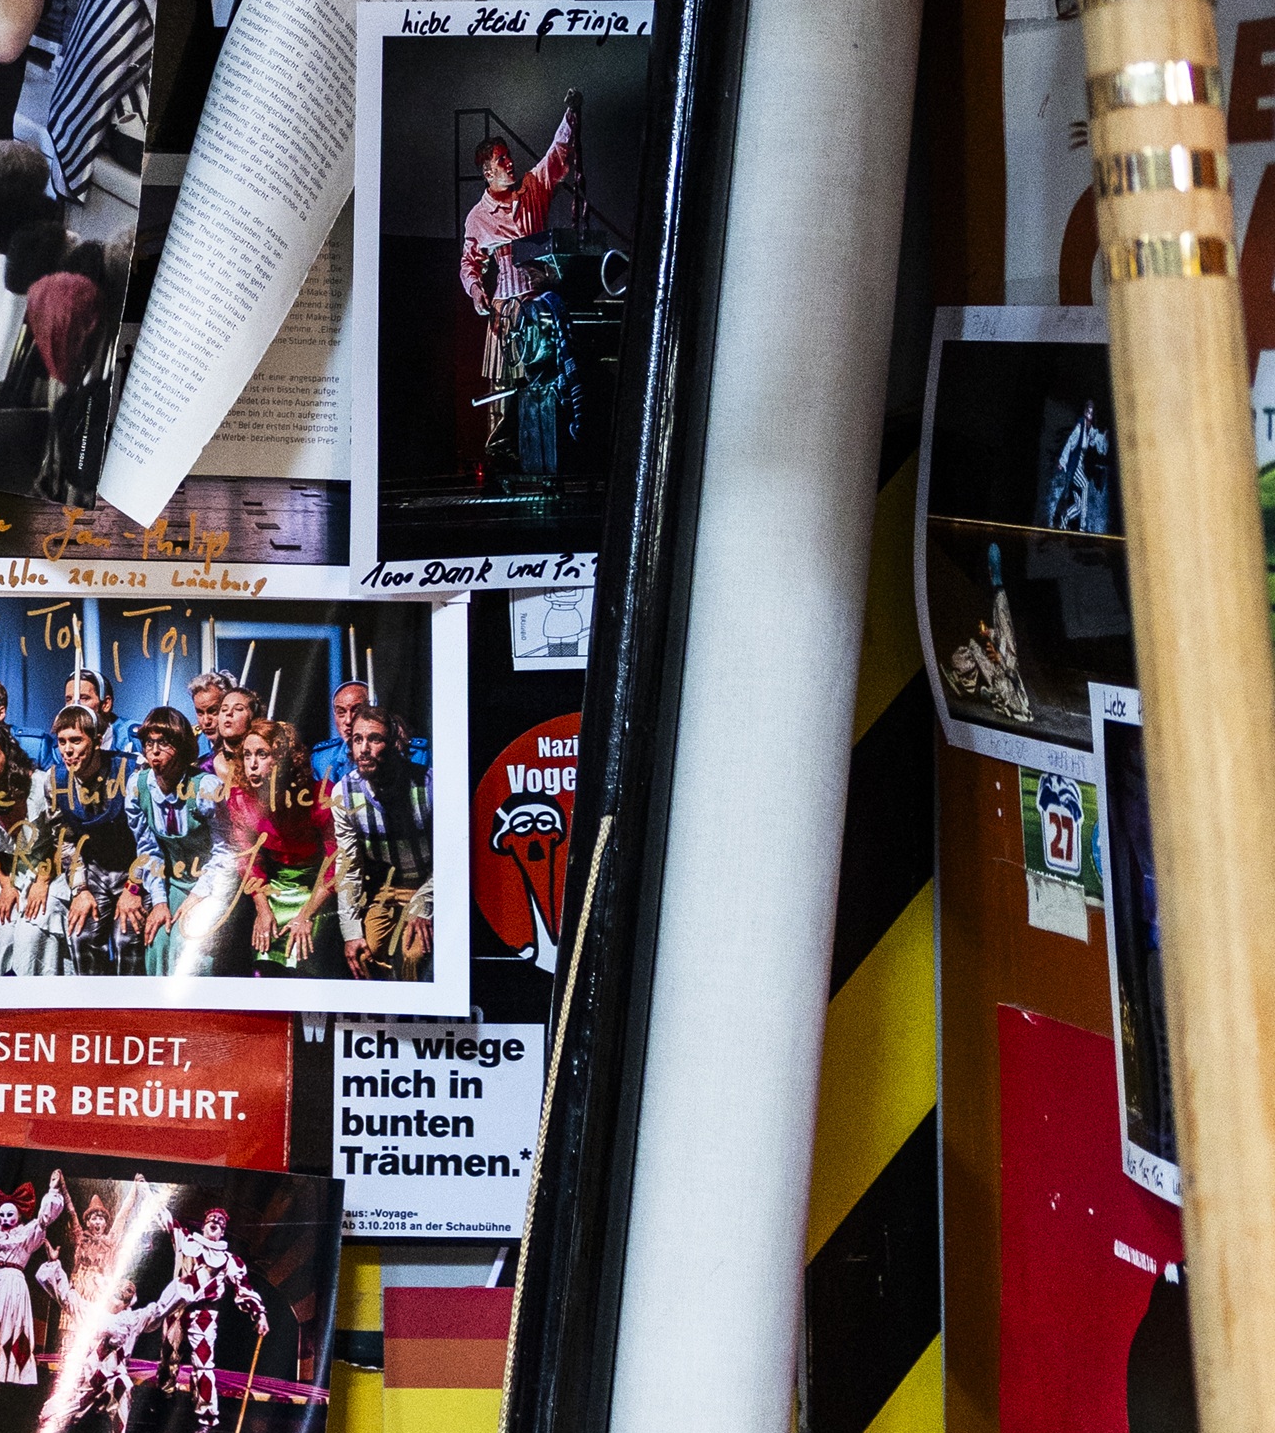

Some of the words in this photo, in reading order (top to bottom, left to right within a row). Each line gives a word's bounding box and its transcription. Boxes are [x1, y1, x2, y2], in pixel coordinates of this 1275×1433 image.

[1049, 812, 1074, 862] 27
[70, 1033, 193, 1072] BILDET,
[343, 1030, 399, 1059] Ich
[412, 1031, 525, 1067] wiege
[69, 1080, 248, 1122] BERÜHRT.
[342, 1069, 436, 1098] mich
[449, 1070, 483, 1099] in
[342, 1107, 474, 1137] bunten
[358, 1222, 406, 1230] 3.10.2018
[425, 1222, 442, 1231] der
[446, 1222, 511, 1231] Schaubühne
